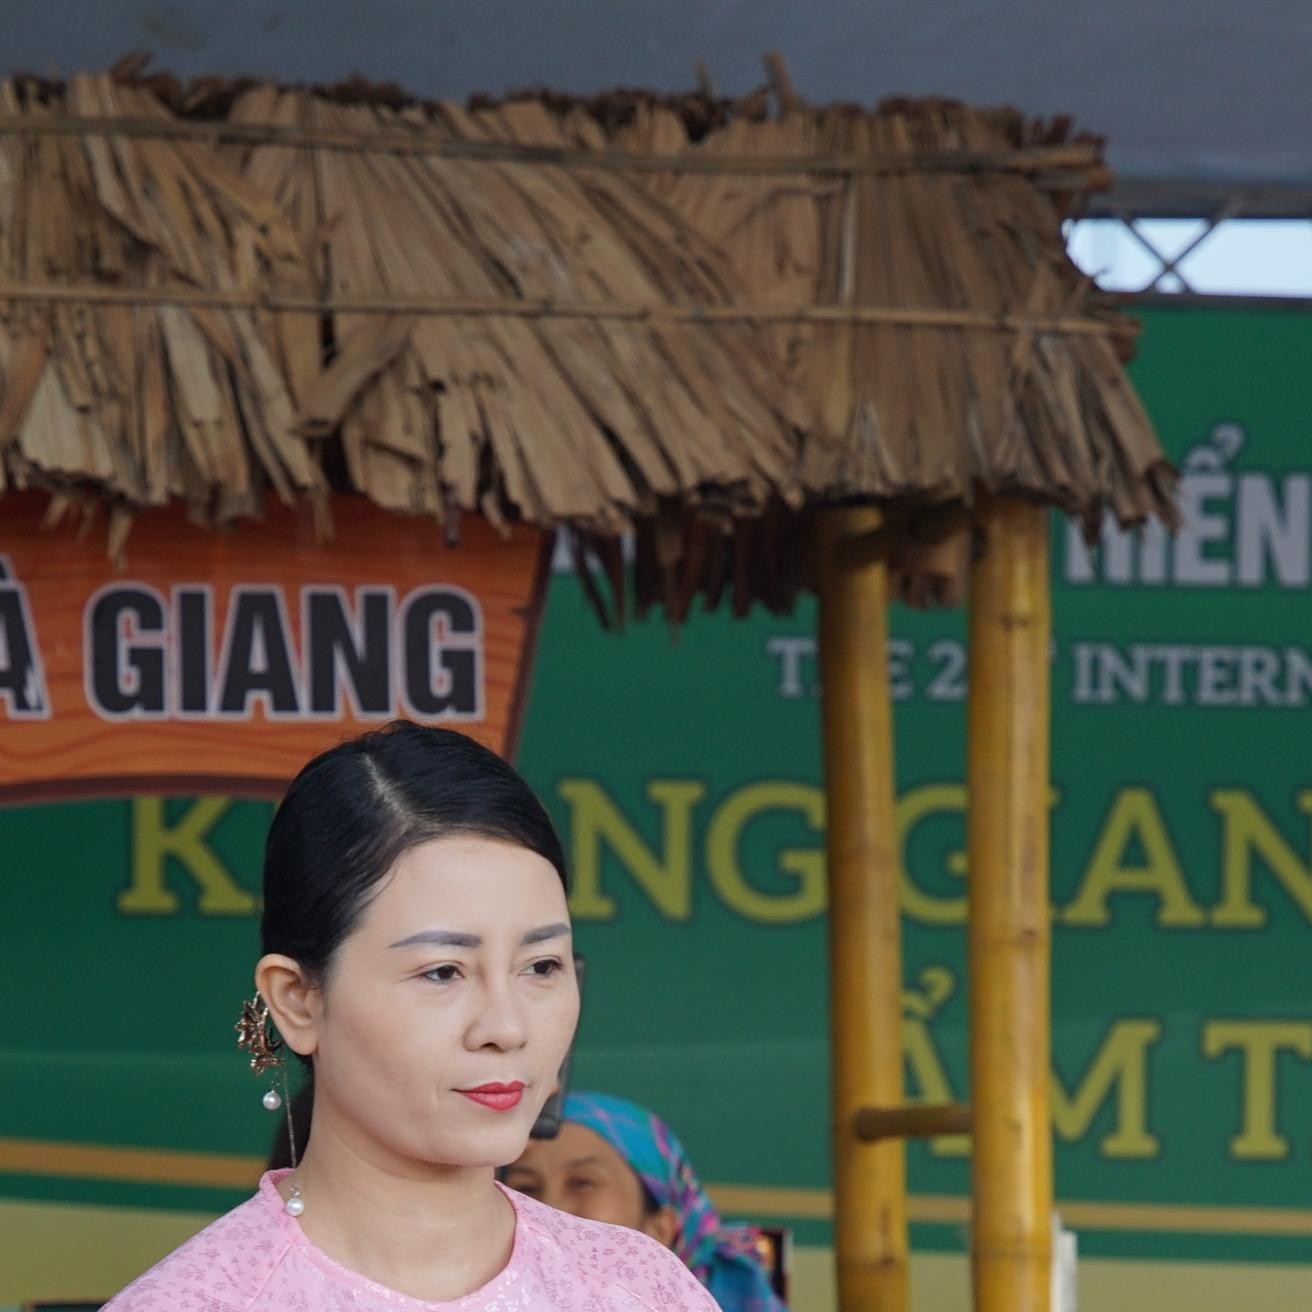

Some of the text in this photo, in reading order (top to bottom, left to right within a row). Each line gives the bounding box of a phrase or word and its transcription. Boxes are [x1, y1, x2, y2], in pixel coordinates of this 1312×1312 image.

[1065, 422, 1312, 586] IỂN
[84, 582, 483, 721] GIANG
[767, 637, 914, 698] TE
[118, 779, 826, 922] KNG
